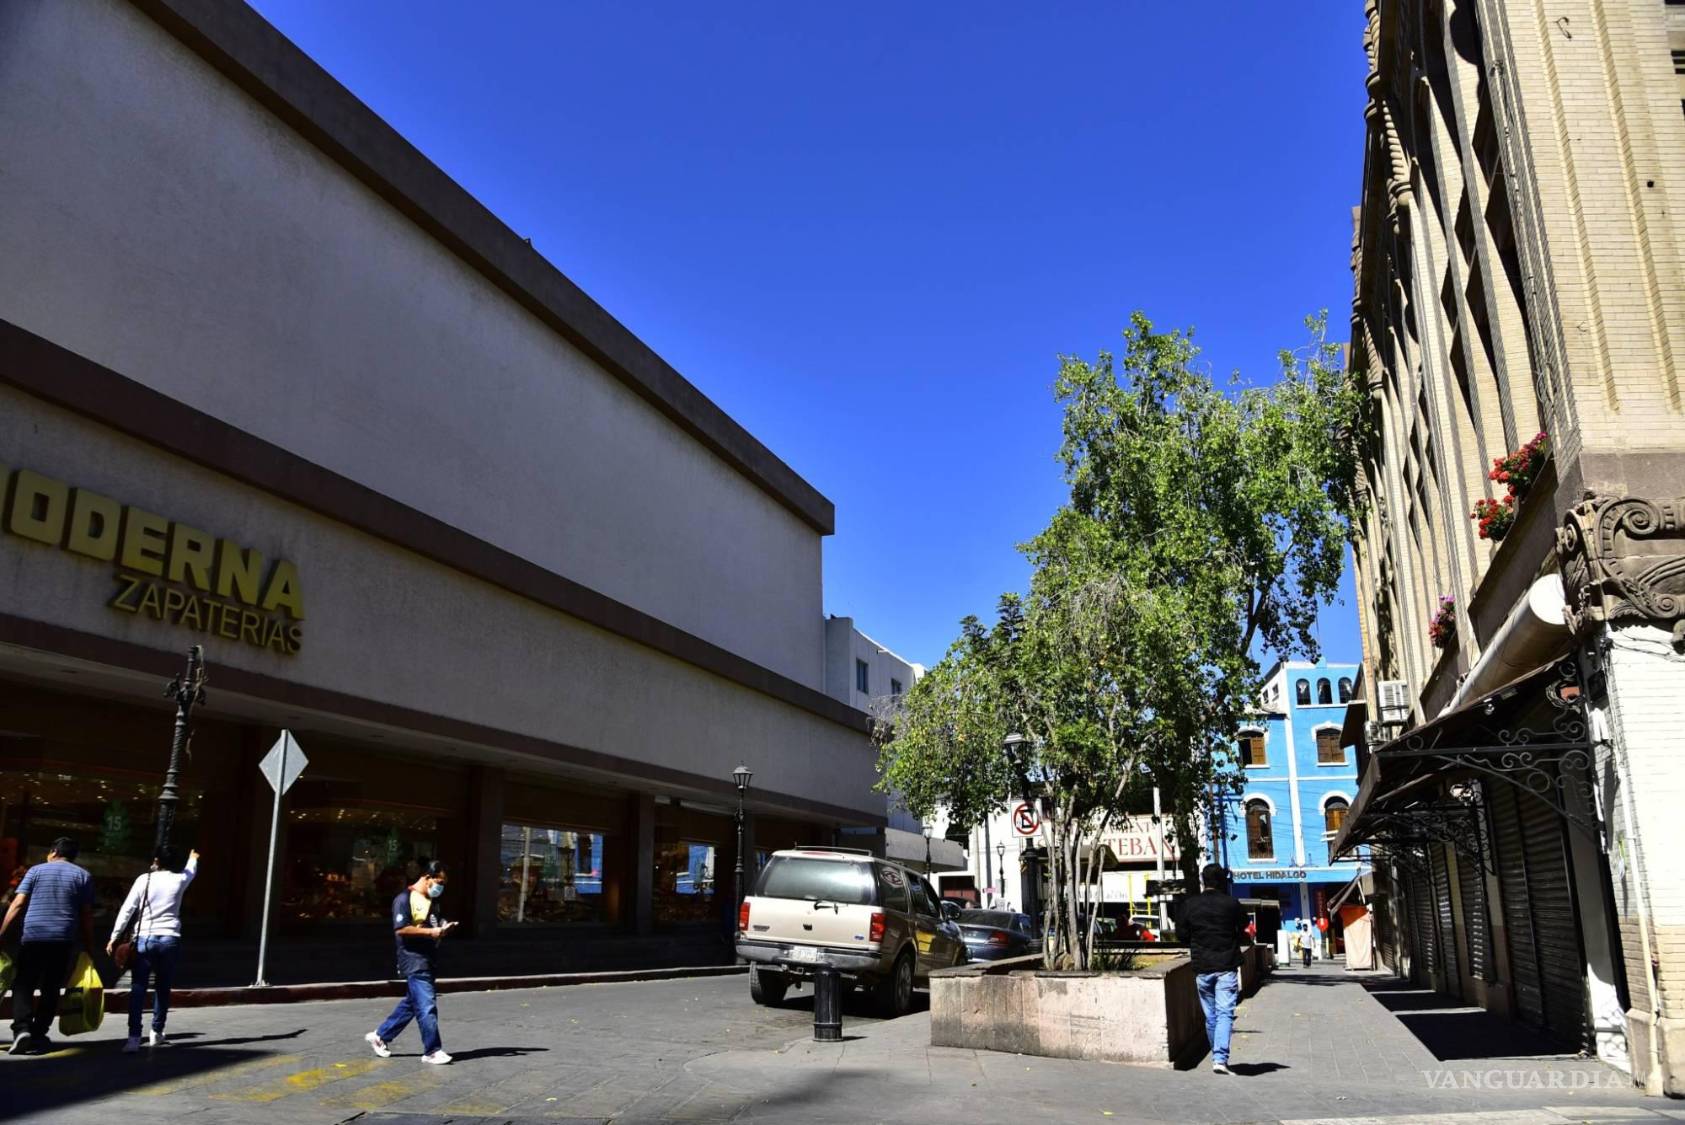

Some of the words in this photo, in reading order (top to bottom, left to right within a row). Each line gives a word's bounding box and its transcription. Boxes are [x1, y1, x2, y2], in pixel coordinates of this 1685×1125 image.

[0, 461, 304, 619] ODERNA
[110, 573, 304, 654] ZAPATERIAS
[1233, 871, 1264, 880] HOTEL
[1266, 870, 1307, 879] HIDALGO
